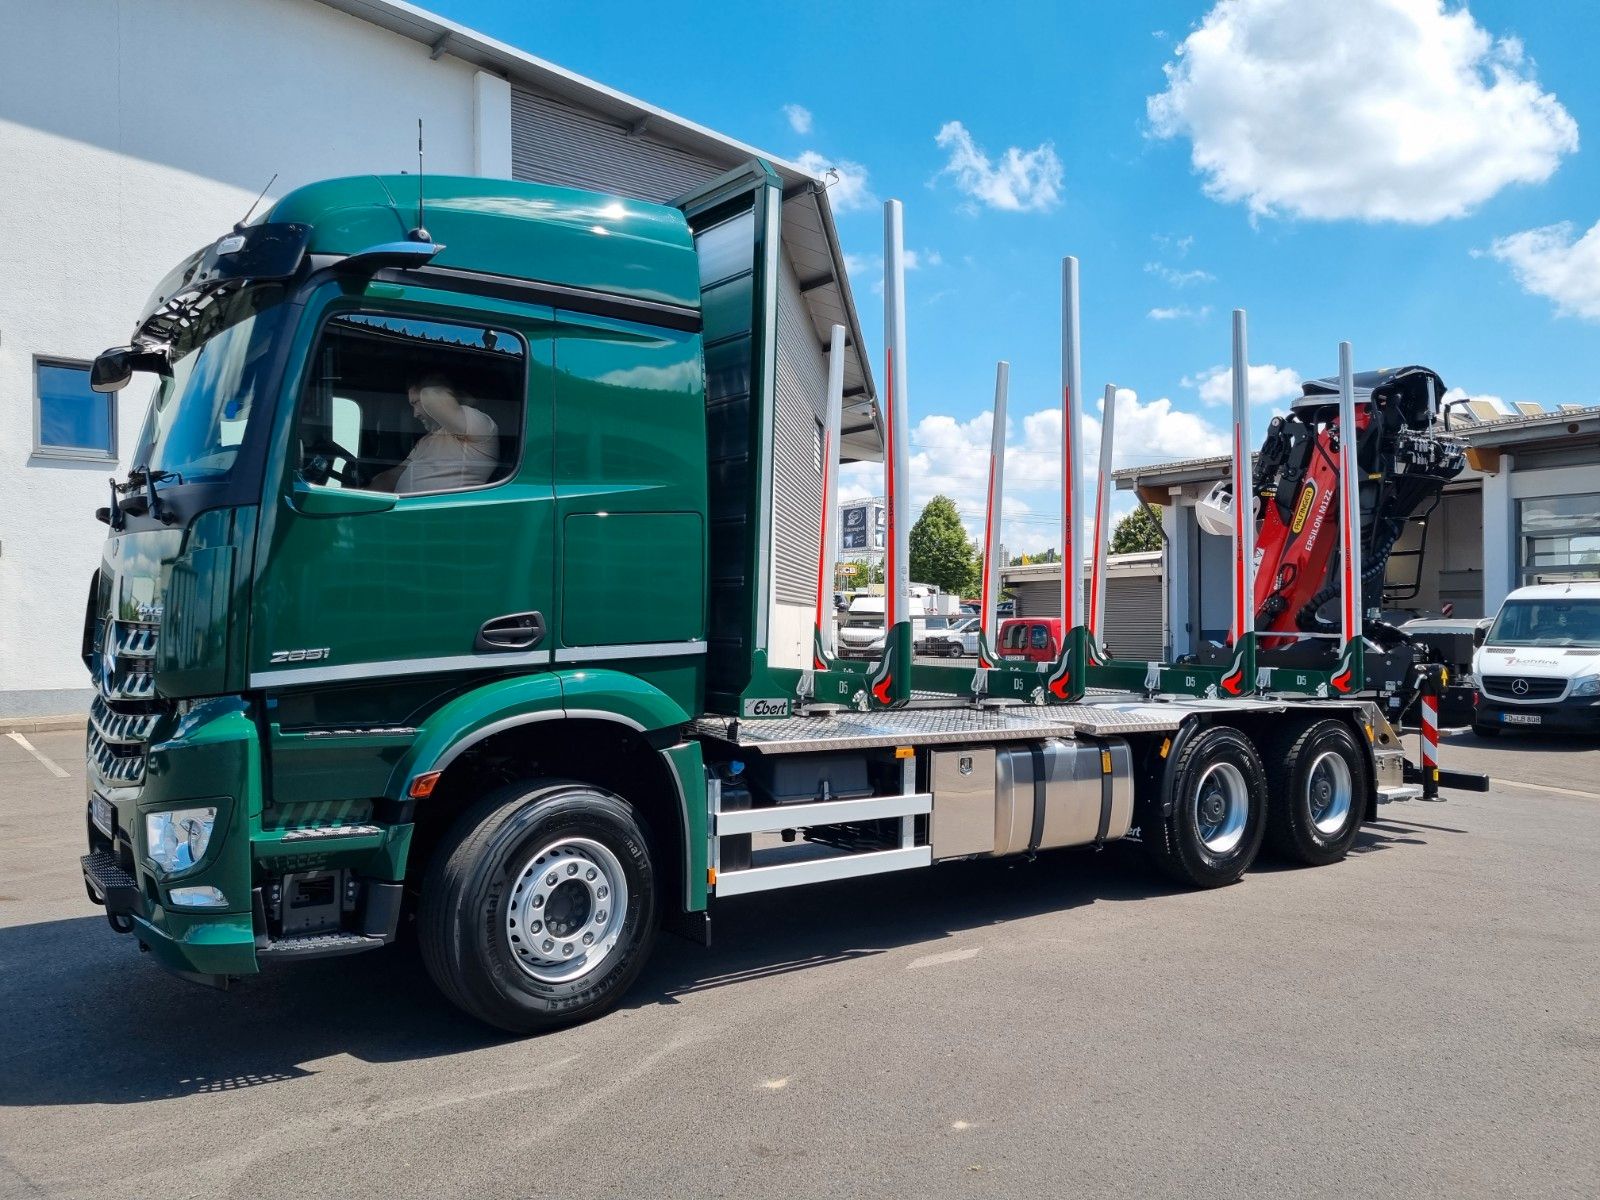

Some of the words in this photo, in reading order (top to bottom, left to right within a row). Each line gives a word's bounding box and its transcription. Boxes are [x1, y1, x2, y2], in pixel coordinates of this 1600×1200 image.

[1294, 489, 1312, 531] PALFINGER
[1305, 515, 1324, 552] EPSILON
[838, 680, 849, 694] D5
[1013, 678, 1024, 691] D5
[753, 700, 787, 715] Ebert
